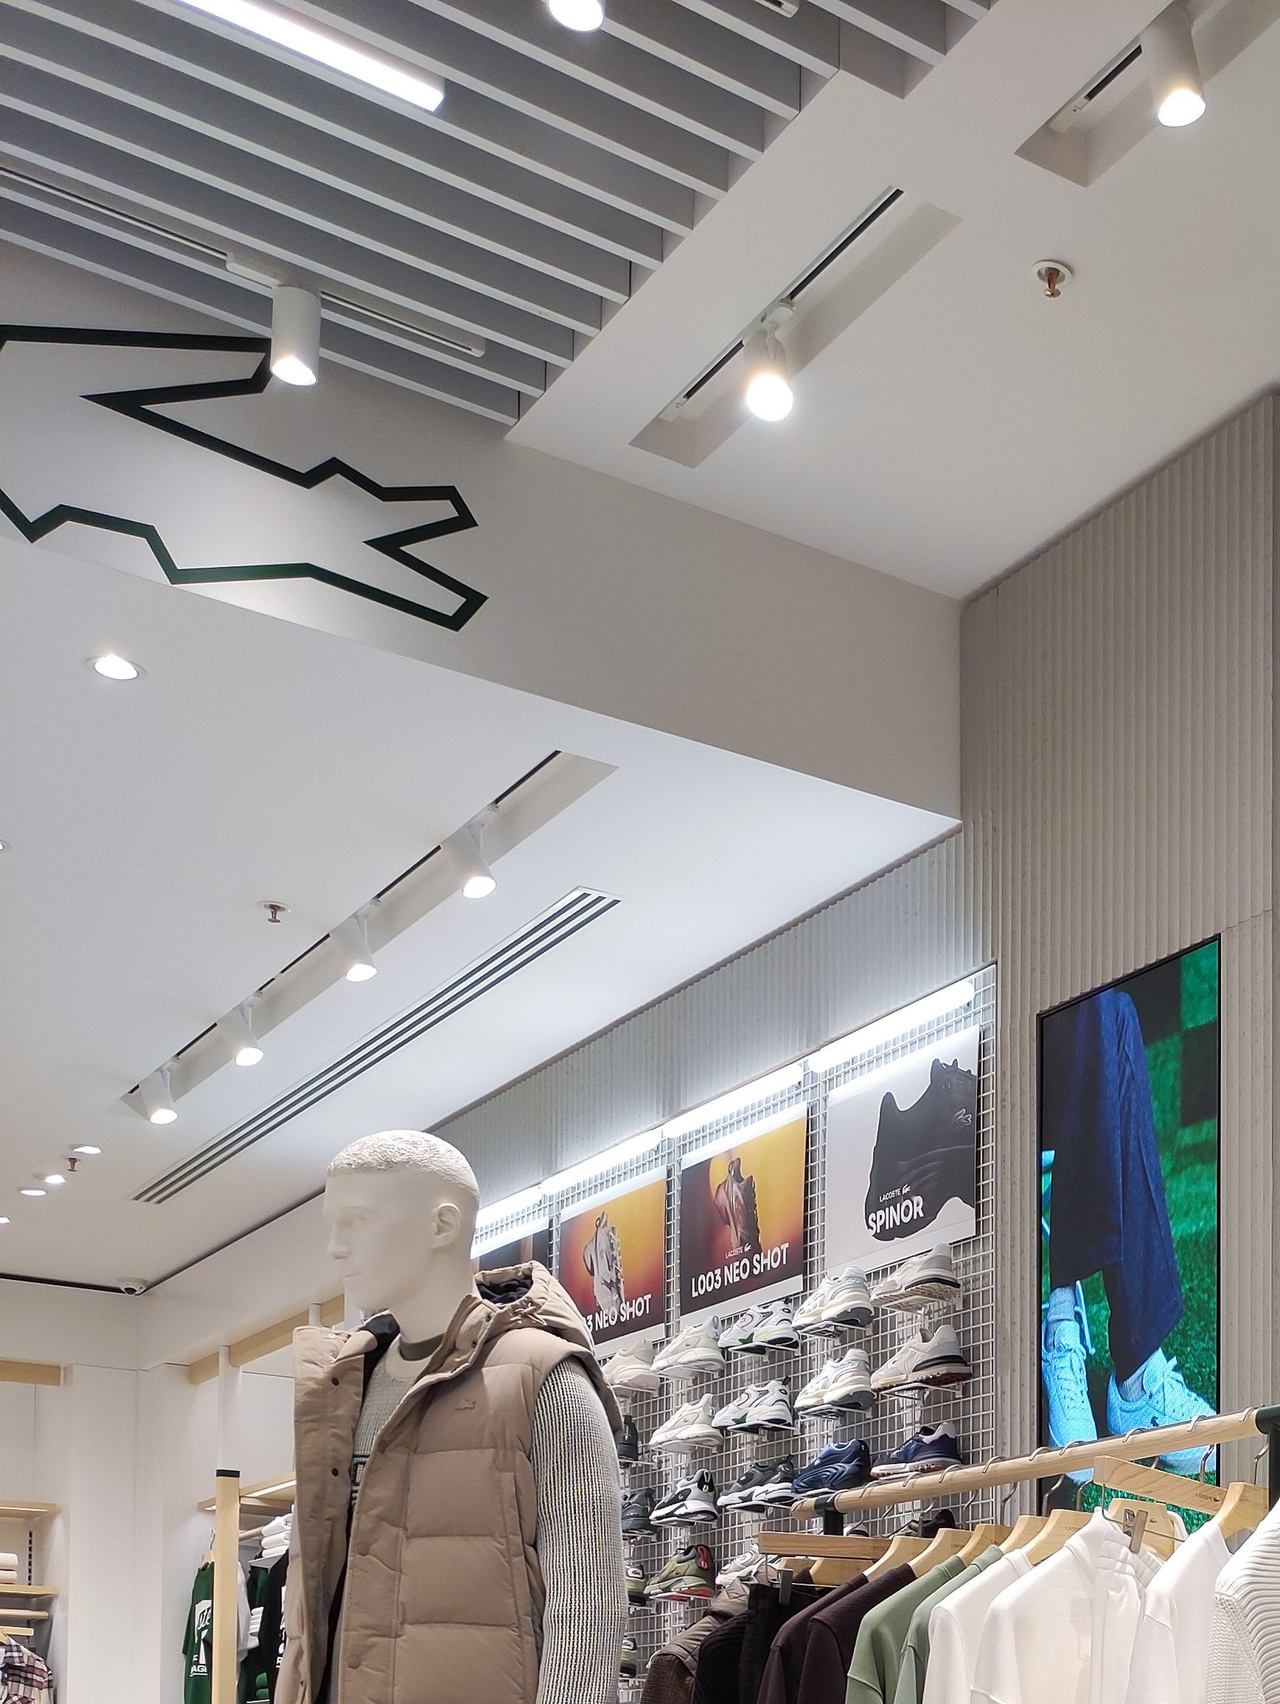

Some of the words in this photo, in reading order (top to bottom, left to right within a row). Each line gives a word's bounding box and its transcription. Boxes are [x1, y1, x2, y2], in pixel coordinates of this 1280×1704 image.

[880, 1187, 901, 1203] LACOSTE
[868, 1195, 924, 1235] SPINOR
[691, 1267, 722, 1298] L003
[724, 1258, 750, 1287] NEO
[753, 1242, 790, 1275] SHOT
[595, 1305, 618, 1331] NEO
[620, 1293, 652, 1322] SHOT
